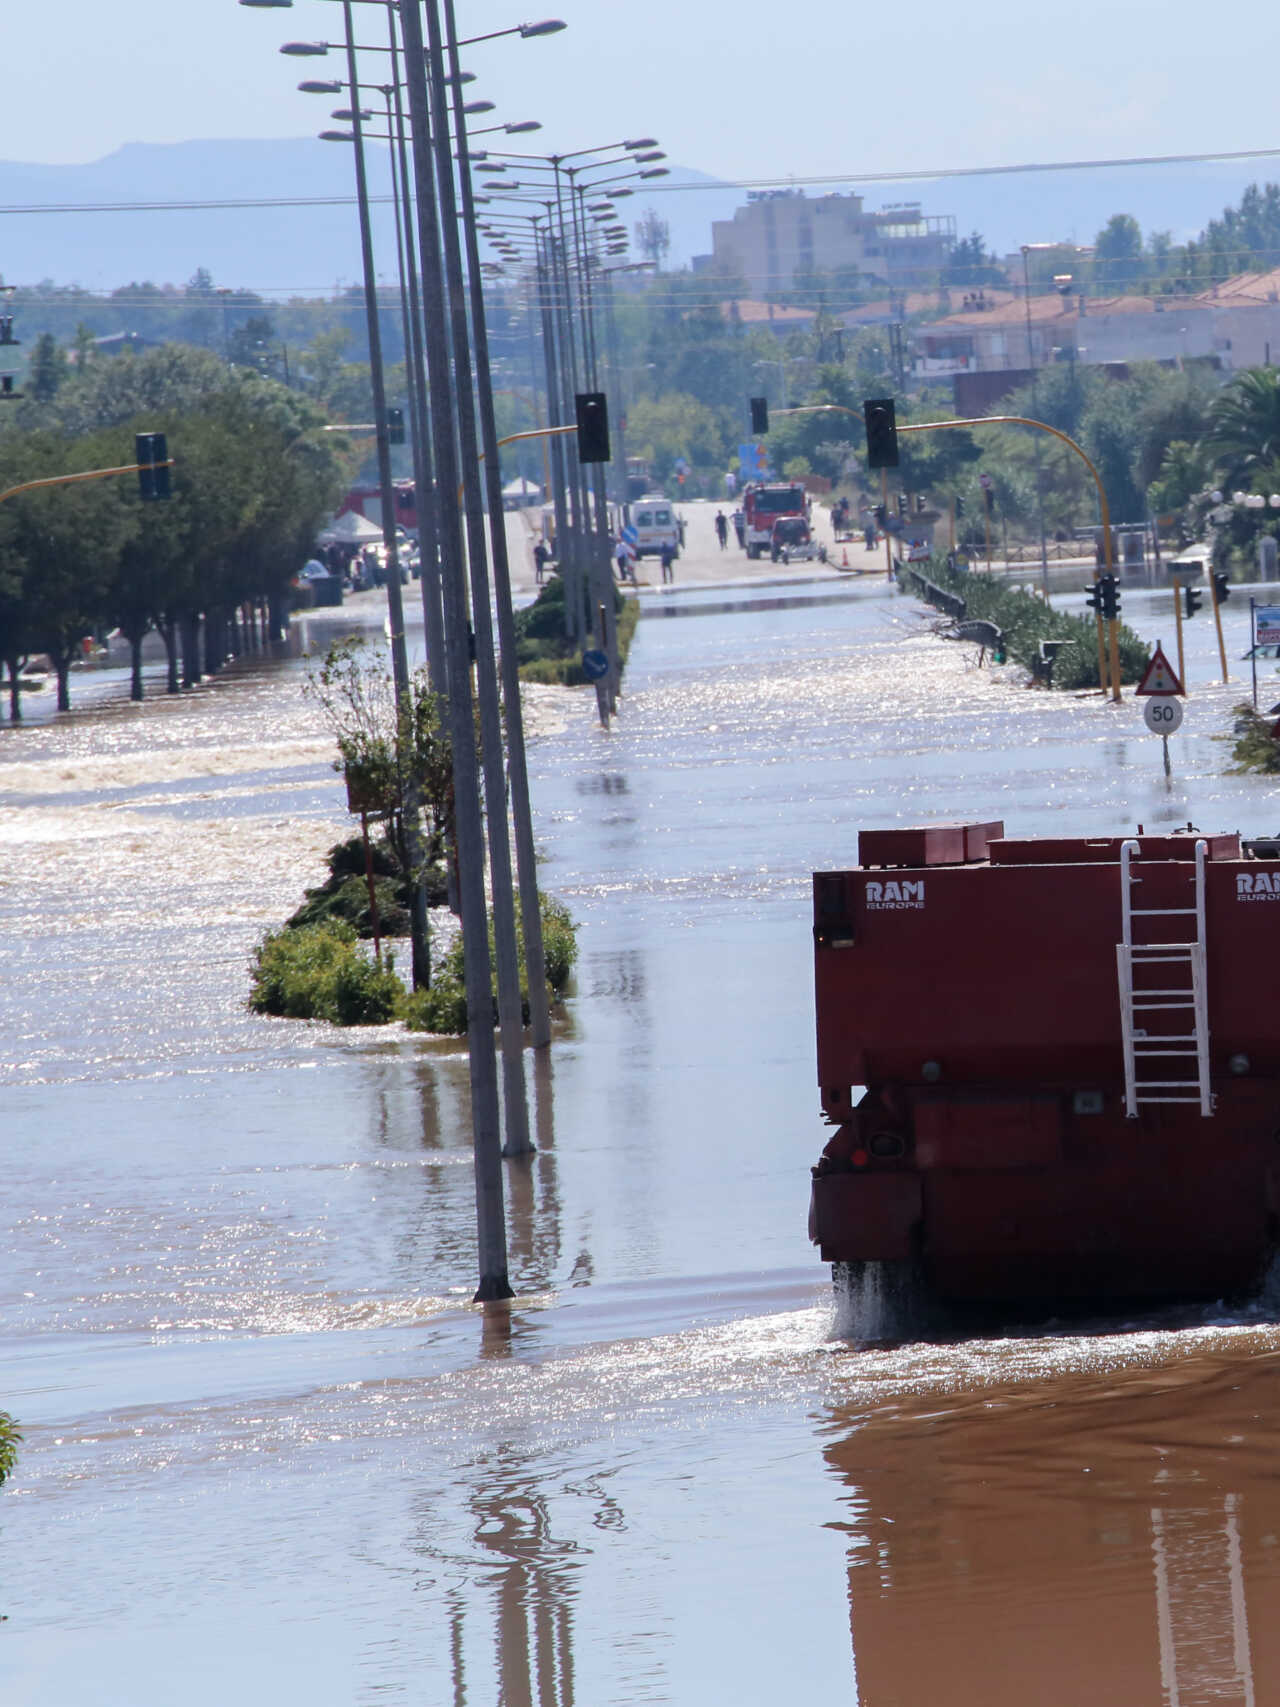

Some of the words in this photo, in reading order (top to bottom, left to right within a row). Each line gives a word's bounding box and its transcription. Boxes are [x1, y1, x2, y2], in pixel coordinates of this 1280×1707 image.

[1152, 705, 1174, 722] 50
[865, 880, 925, 902] RAM
[866, 901, 925, 910] EUROPE
